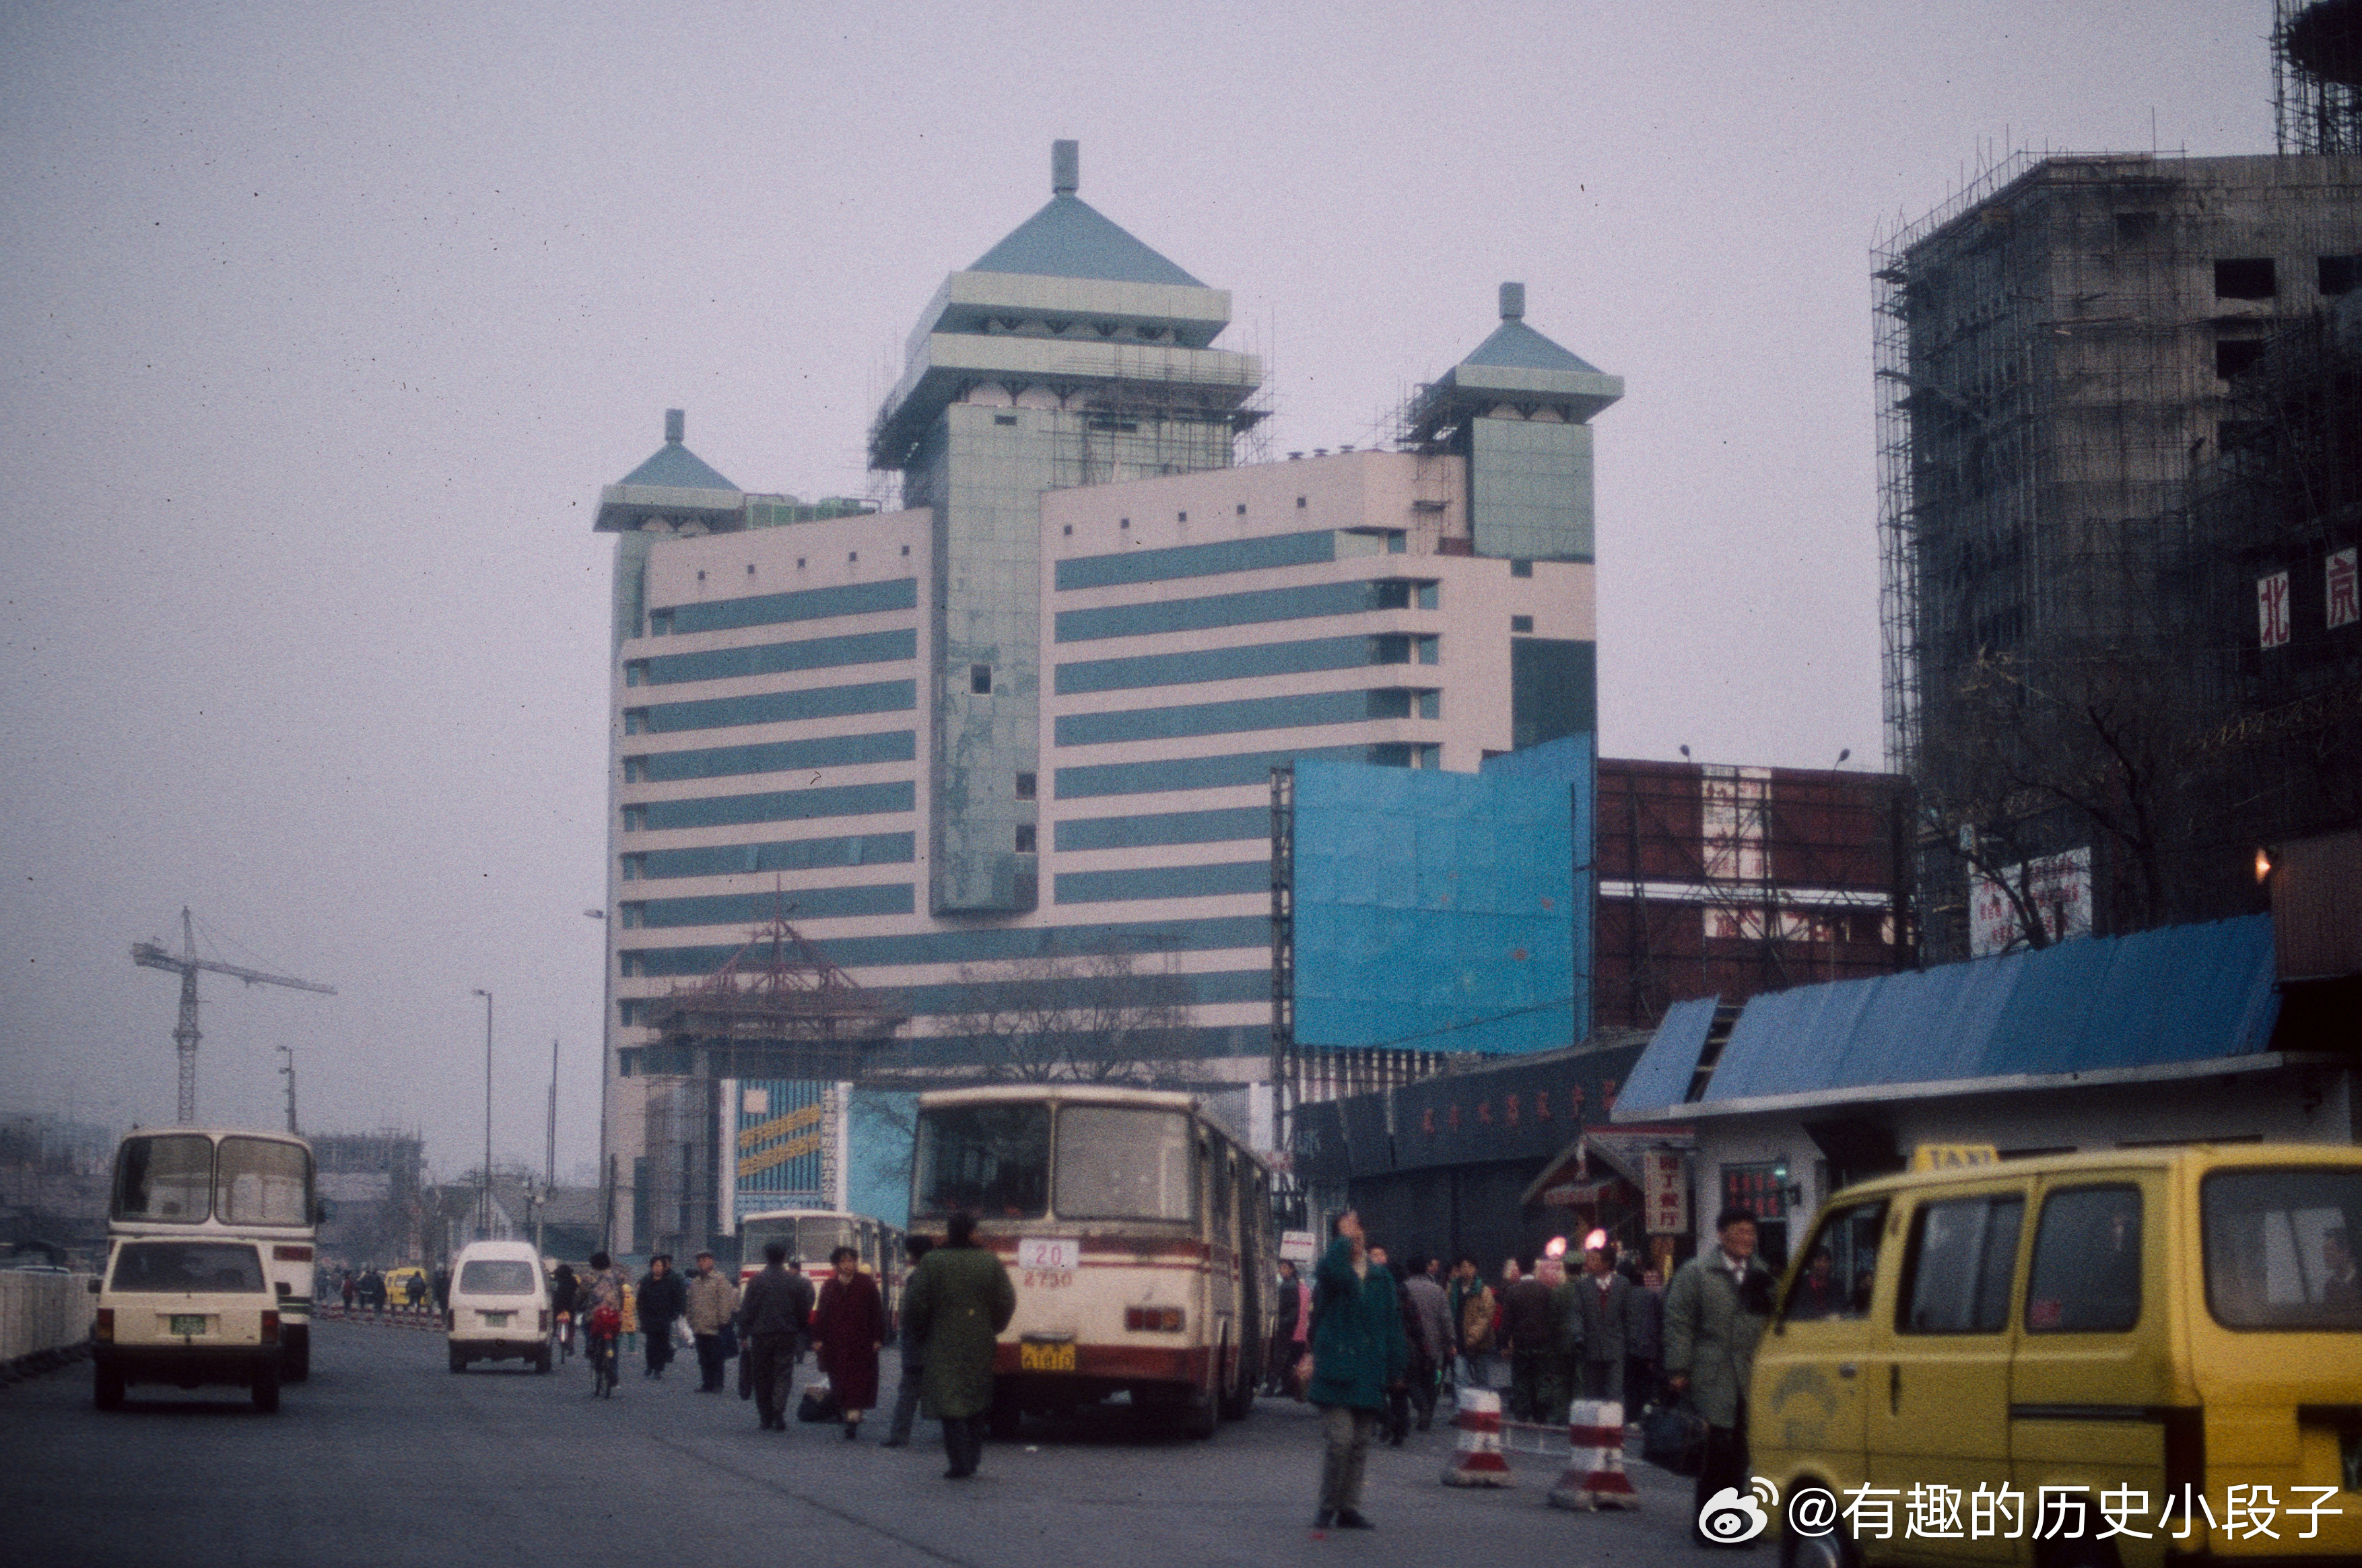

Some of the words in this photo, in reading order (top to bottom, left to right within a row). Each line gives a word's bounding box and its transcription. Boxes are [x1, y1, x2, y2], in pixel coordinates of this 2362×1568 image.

[2260, 556, 2359, 646] 北京
[1929, 1149, 1992, 1170] TAXI
[1036, 1244, 1062, 1266] 20
